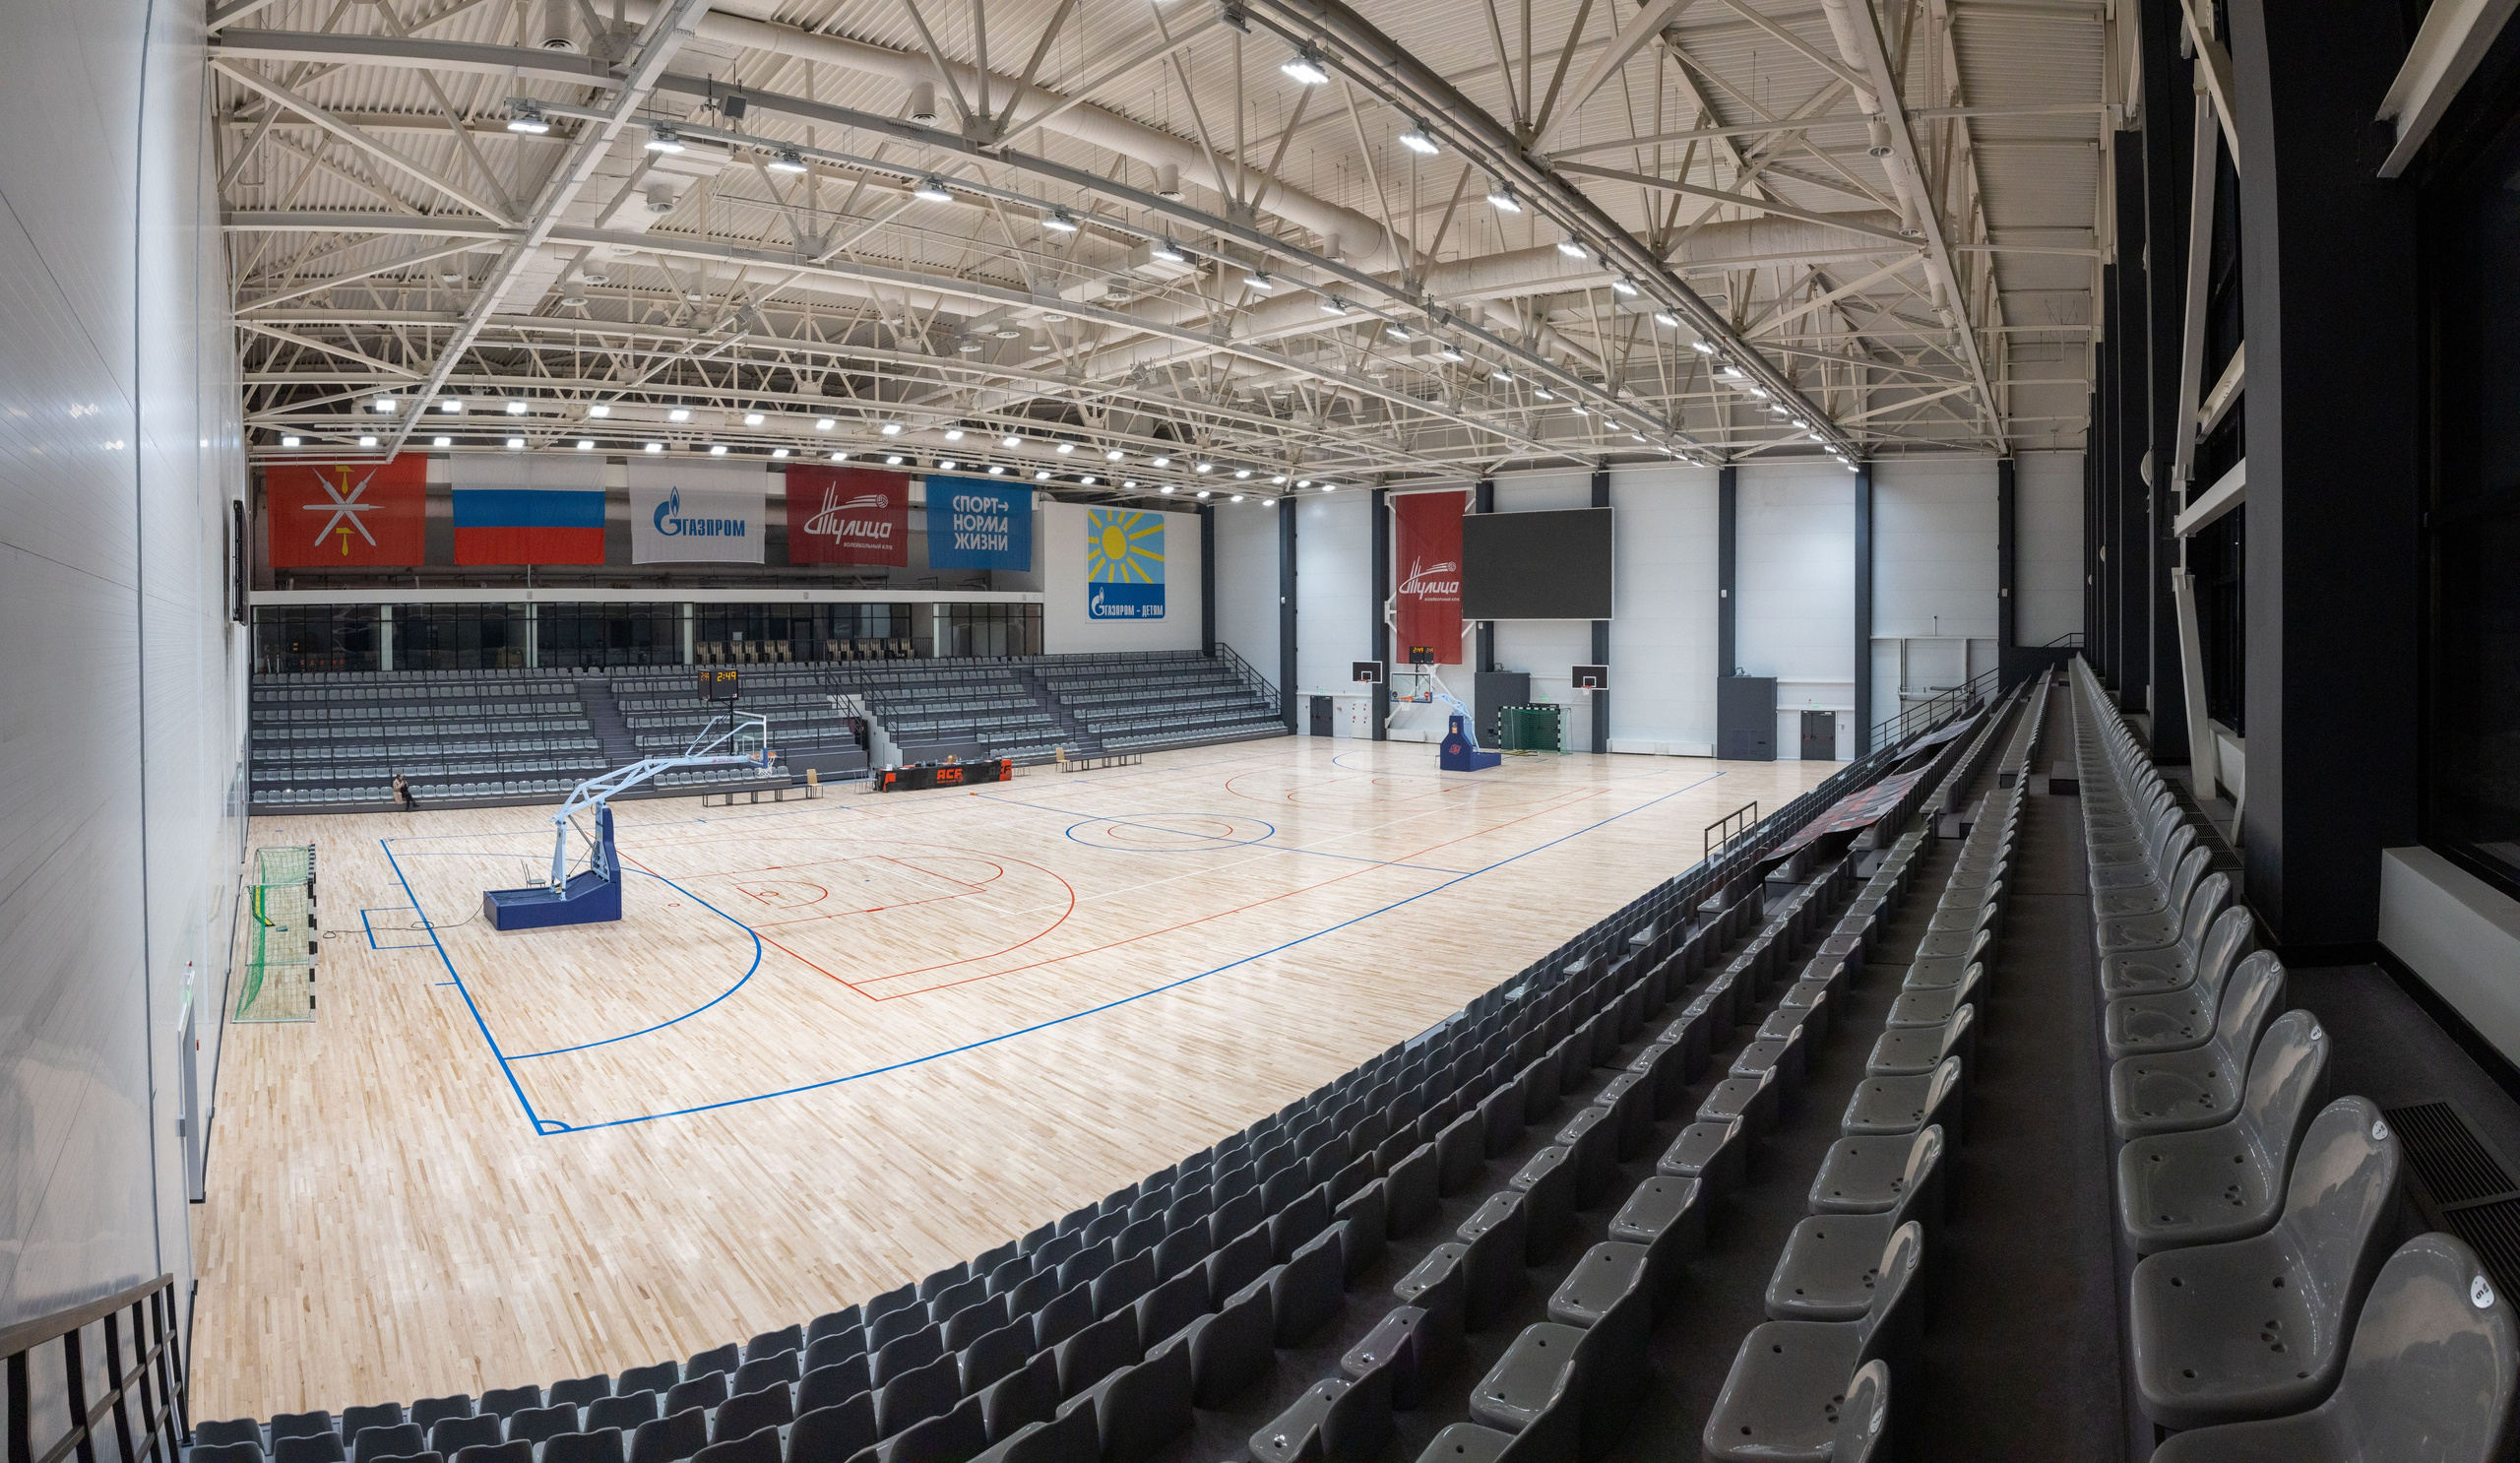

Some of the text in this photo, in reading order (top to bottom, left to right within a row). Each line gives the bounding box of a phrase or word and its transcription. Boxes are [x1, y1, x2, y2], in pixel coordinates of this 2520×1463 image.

[952, 495, 999, 514] СПОРТ
[682, 519, 745, 538] ГАЗПРОМ
[953, 514, 1008, 533] НОРМА
[954, 533, 1008, 551] ЖИЗНИ
[1104, 604, 1134, 616] ГАЗПРОМ
[1142, 605, 1164, 617] ДЕТЯМ
[717, 671, 737, 682] 2:49
